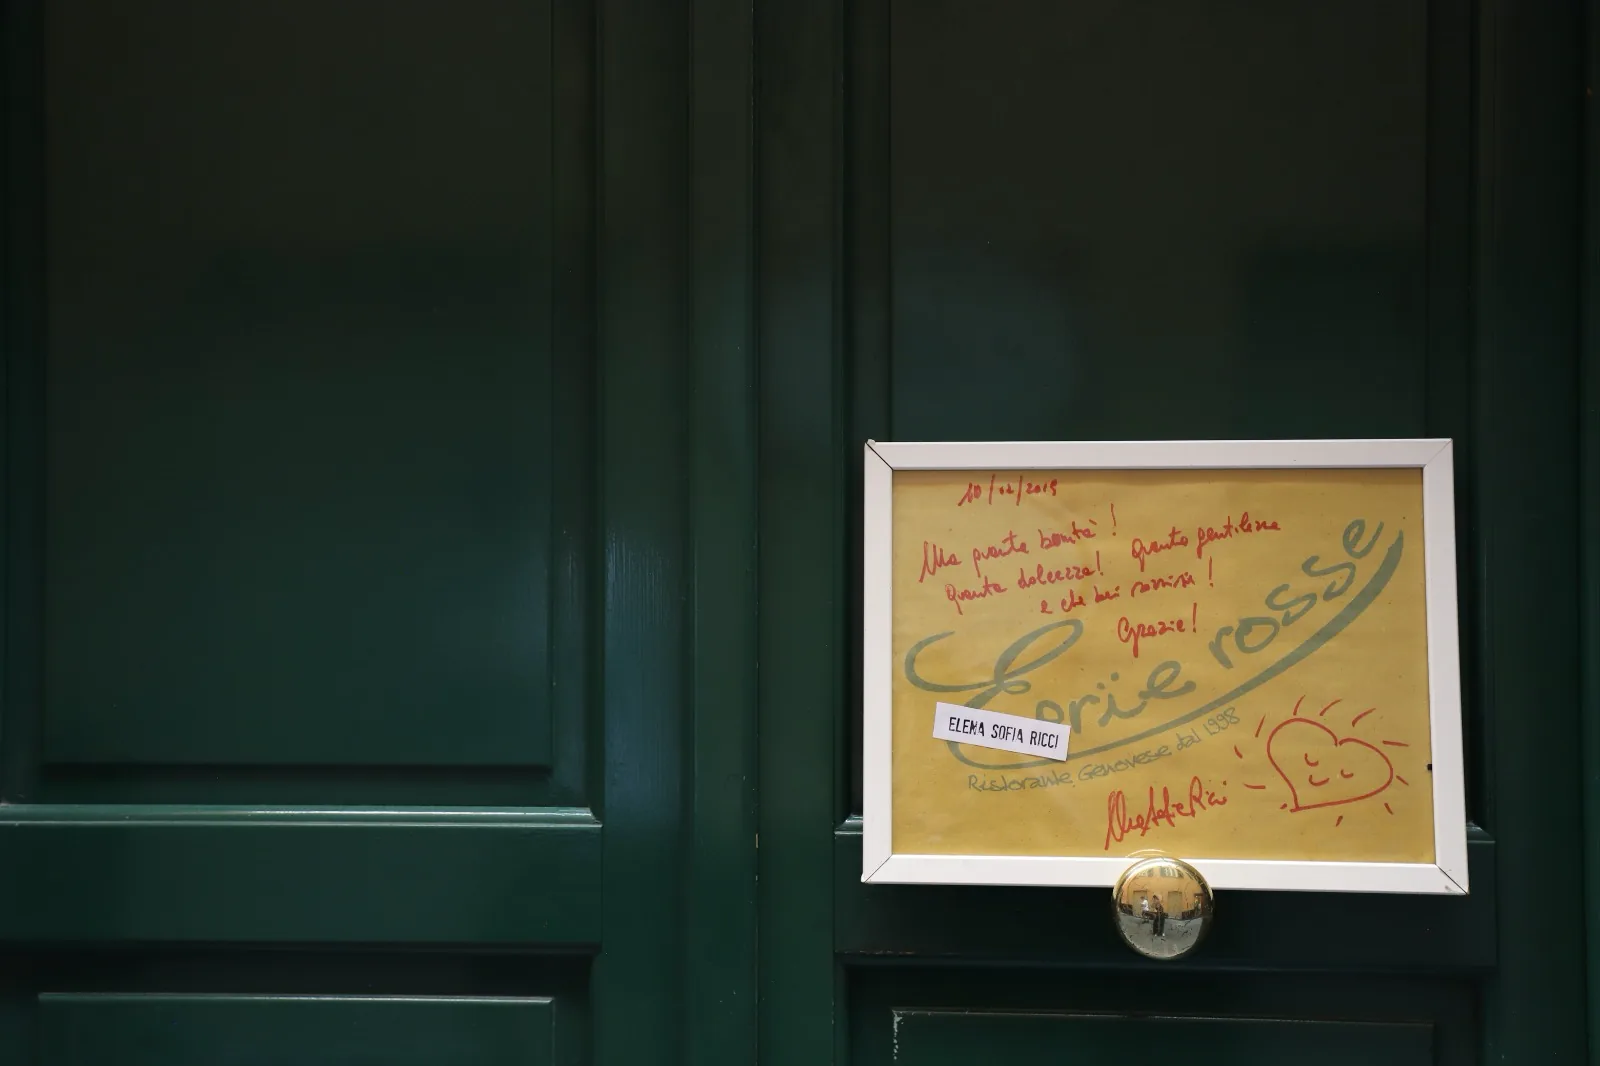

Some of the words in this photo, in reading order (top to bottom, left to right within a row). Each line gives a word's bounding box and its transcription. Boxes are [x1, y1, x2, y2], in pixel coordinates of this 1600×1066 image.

[918, 540, 962, 583] Ma
[1041, 600, 1053, 614] e
[1061, 589, 1086, 612] che
[1208, 519, 1384, 669] rosse
[948, 717, 985, 737] ELENA
[991, 724, 1024, 744] SOFIA
[1029, 730, 1060, 750] RICCI
[968, 770, 1072, 792] Ristorante
[1078, 745, 1172, 781] Genovese
[1176, 729, 1200, 751] dal
[1202, 707, 1240, 737] 1998
